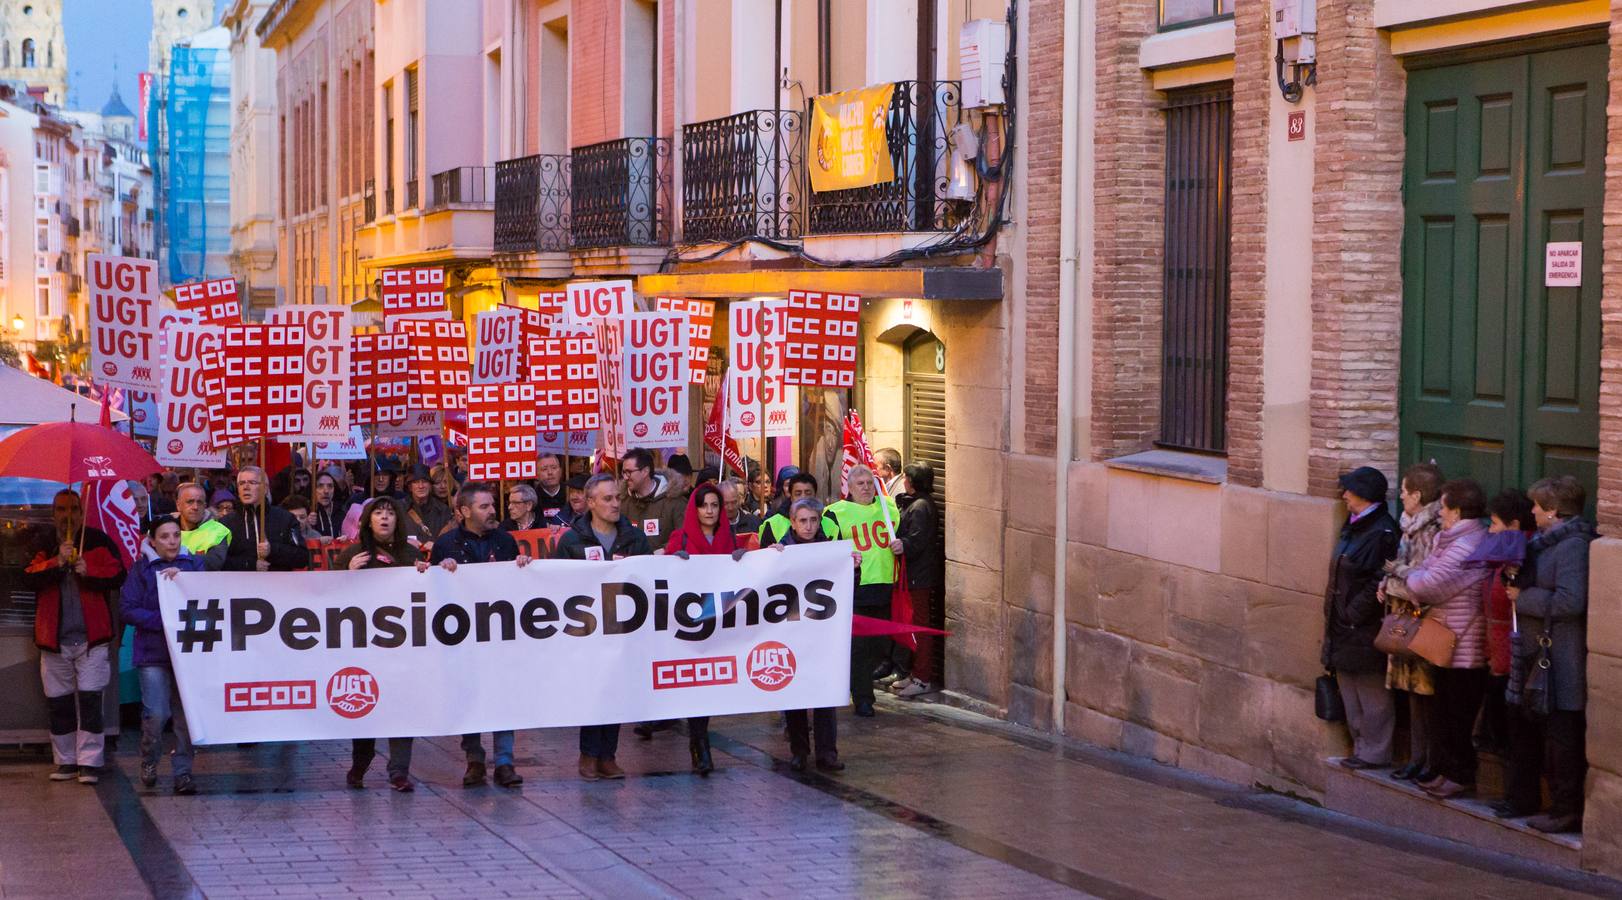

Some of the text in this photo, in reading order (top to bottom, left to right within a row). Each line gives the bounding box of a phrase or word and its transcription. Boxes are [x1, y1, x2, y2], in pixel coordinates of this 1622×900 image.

[1291, 117, 1303, 134] 83
[94, 260, 151, 294] UGT
[96, 294, 152, 327] UGT
[574, 287, 626, 317] UGT
[481, 315, 516, 346] UGT
[631, 318, 683, 348] UGT
[736, 307, 788, 337] UGT
[97, 327, 153, 361] UGT
[597, 324, 618, 356] UGT
[306, 346, 344, 374] GT
[478, 349, 514, 379] UGT
[631, 352, 683, 382] UGT
[736, 341, 786, 371] UGT
[170, 367, 206, 398] UG
[599, 360, 620, 391] UGT
[737, 375, 785, 405] UGT
[305, 380, 343, 409] GT
[631, 386, 683, 416] UGT
[166, 403, 209, 433] UG
[602, 394, 623, 426] UGT
[851, 520, 896, 551] UG
[176, 579, 838, 653] #PensionesDignas
[656, 648, 792, 685] CCOO UGT
[229, 674, 374, 708] CCOO UGT
